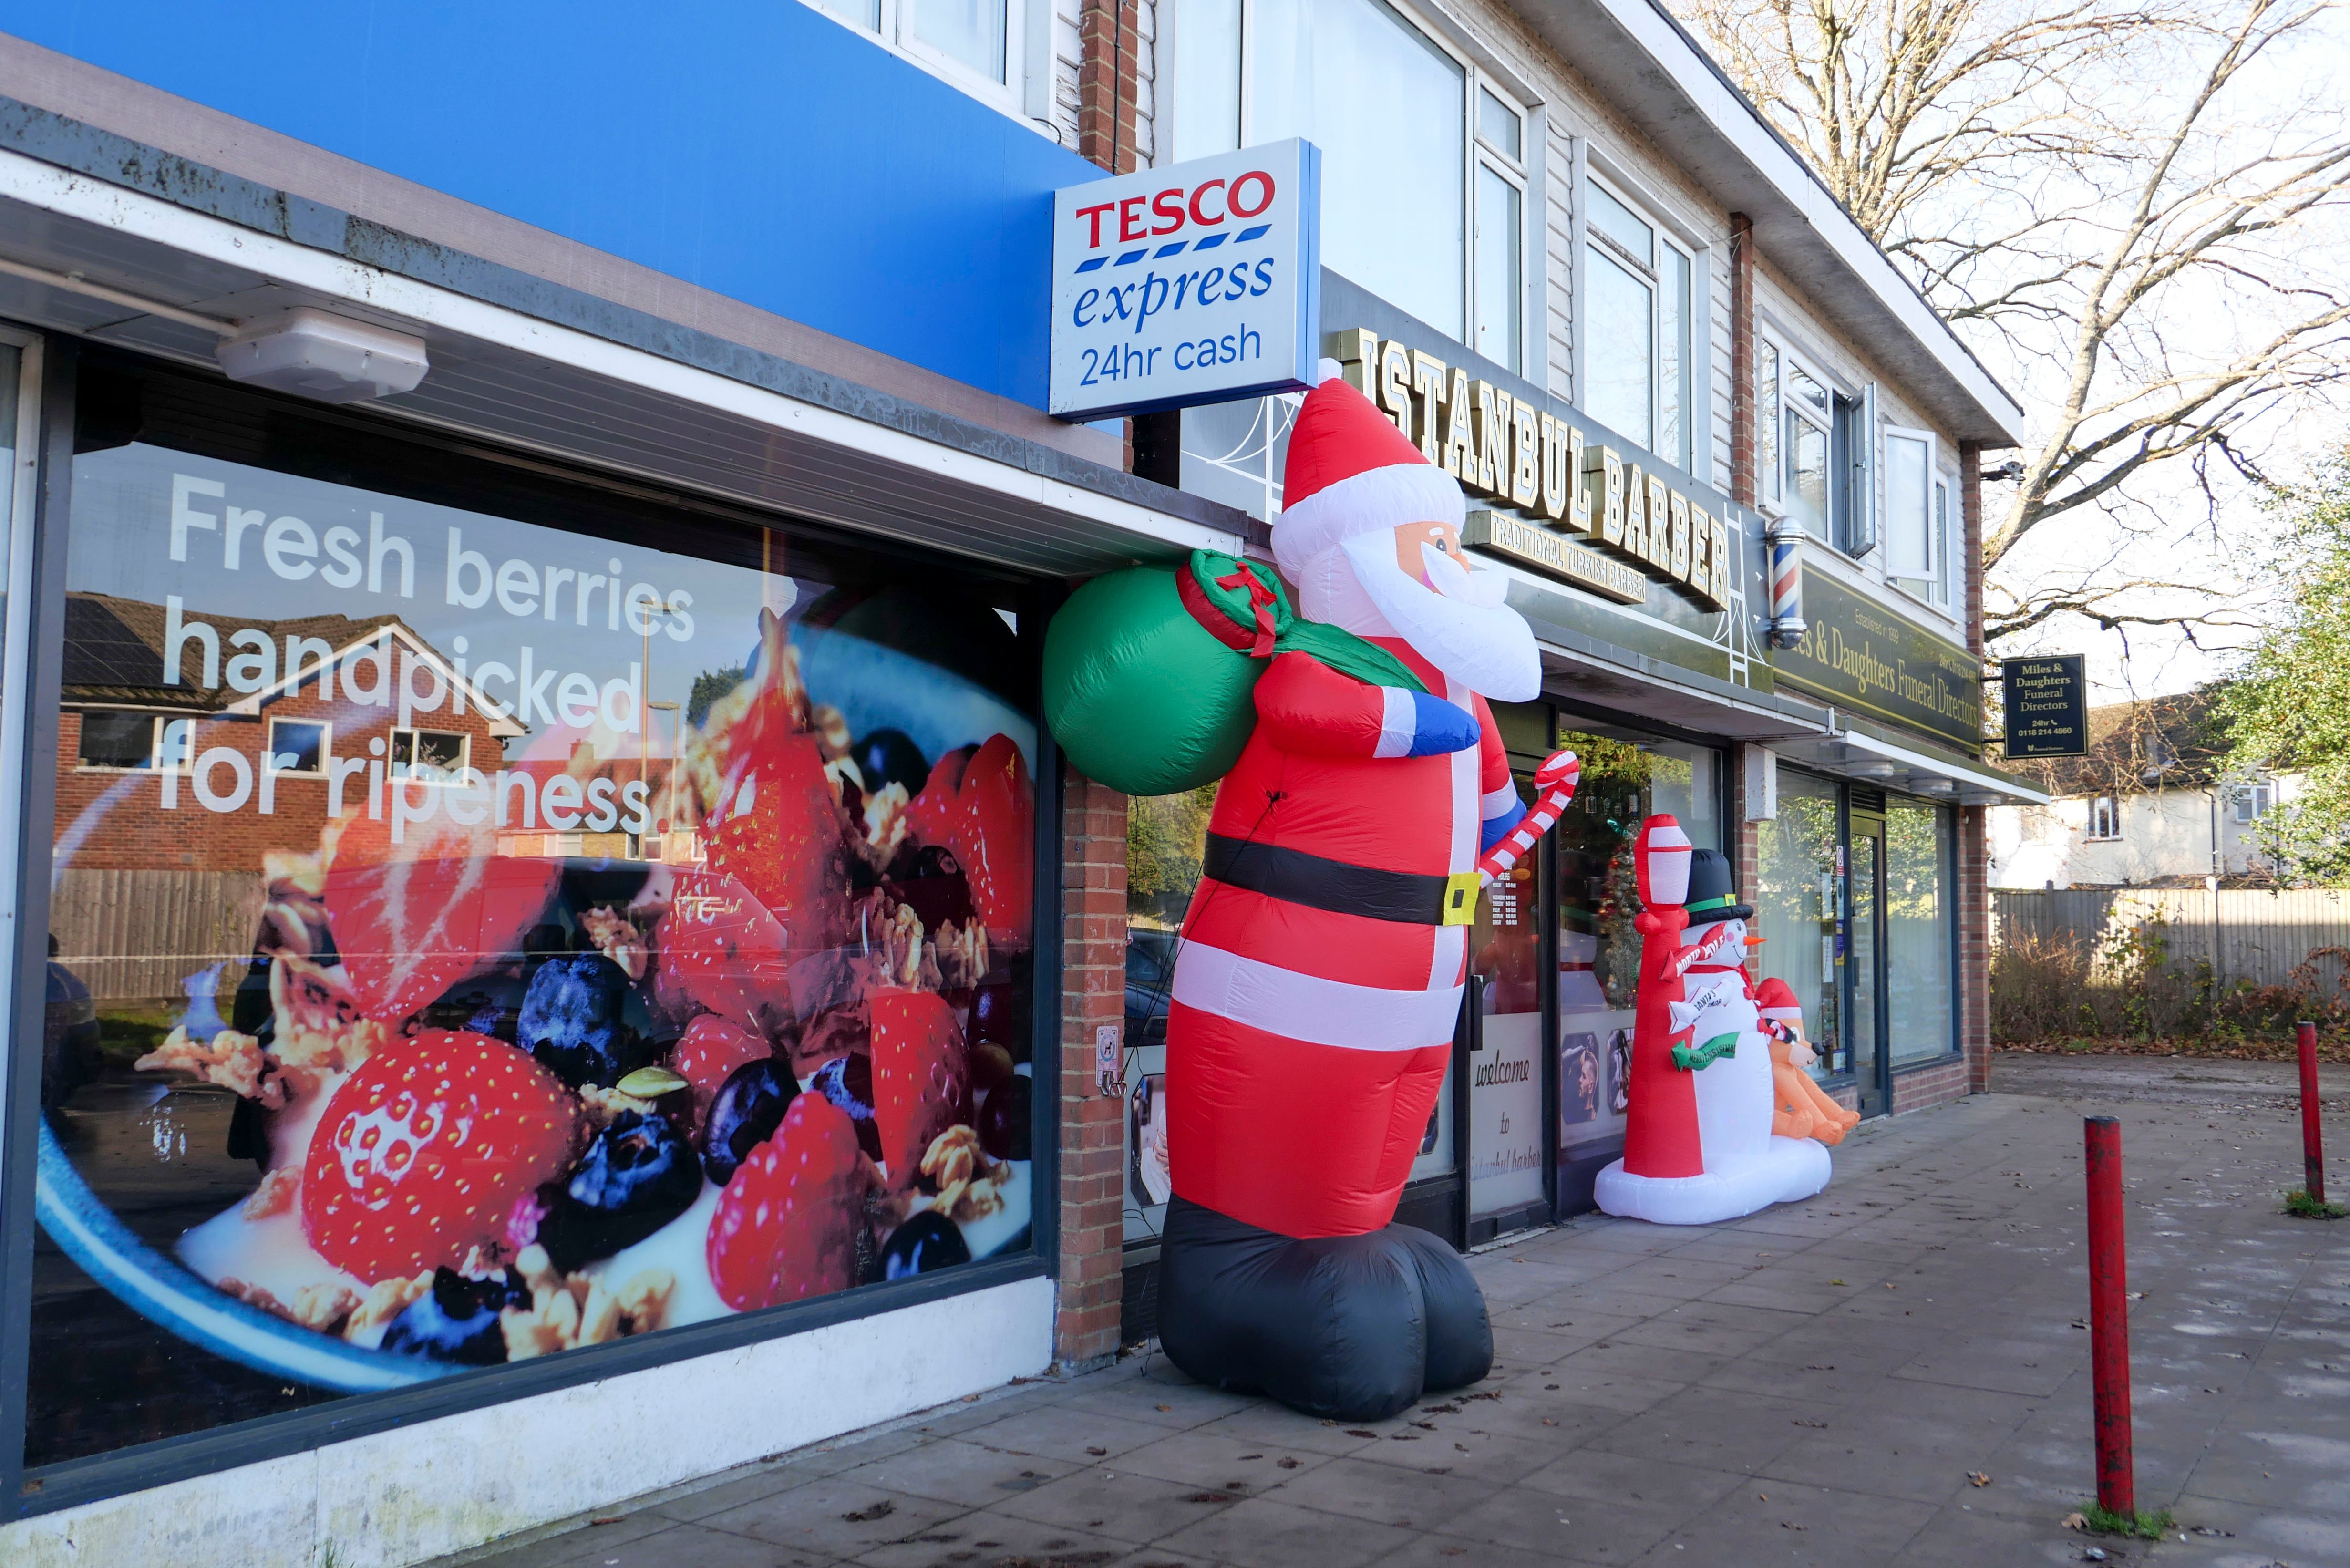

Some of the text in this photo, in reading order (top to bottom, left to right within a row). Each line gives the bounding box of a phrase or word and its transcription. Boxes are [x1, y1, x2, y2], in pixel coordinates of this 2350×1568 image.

[1076, 170, 1275, 249] TESCO
[1073, 257, 1274, 334] express
[1080, 323, 1260, 386] 24hr cash
[1359, 328, 1728, 611] ISTANBUL BARBER
[169, 473, 695, 642] Fresh berries
[1492, 515, 1645, 599] TRADITIONAL TURKISH BARBER
[1855, 608, 1899, 645] Established in 1999
[163, 595, 640, 732] handpicked
[1816, 619, 1829, 665] &
[1832, 627, 1895, 694] Daughters
[1897, 658, 1936, 710] Funeral
[1938, 677, 1978, 728] Directors
[2016, 676, 2071, 689] Daughters
[2022, 663, 2063, 675] Miles &
[2024, 687, 2063, 700] Funeral
[2020, 701, 2068, 712] Directors
[160, 719, 299, 815] for
[1475, 1049, 1530, 1088] welcome
[1500, 1111, 1510, 1134] to
[1470, 1145, 1541, 1182] istanbul barber
